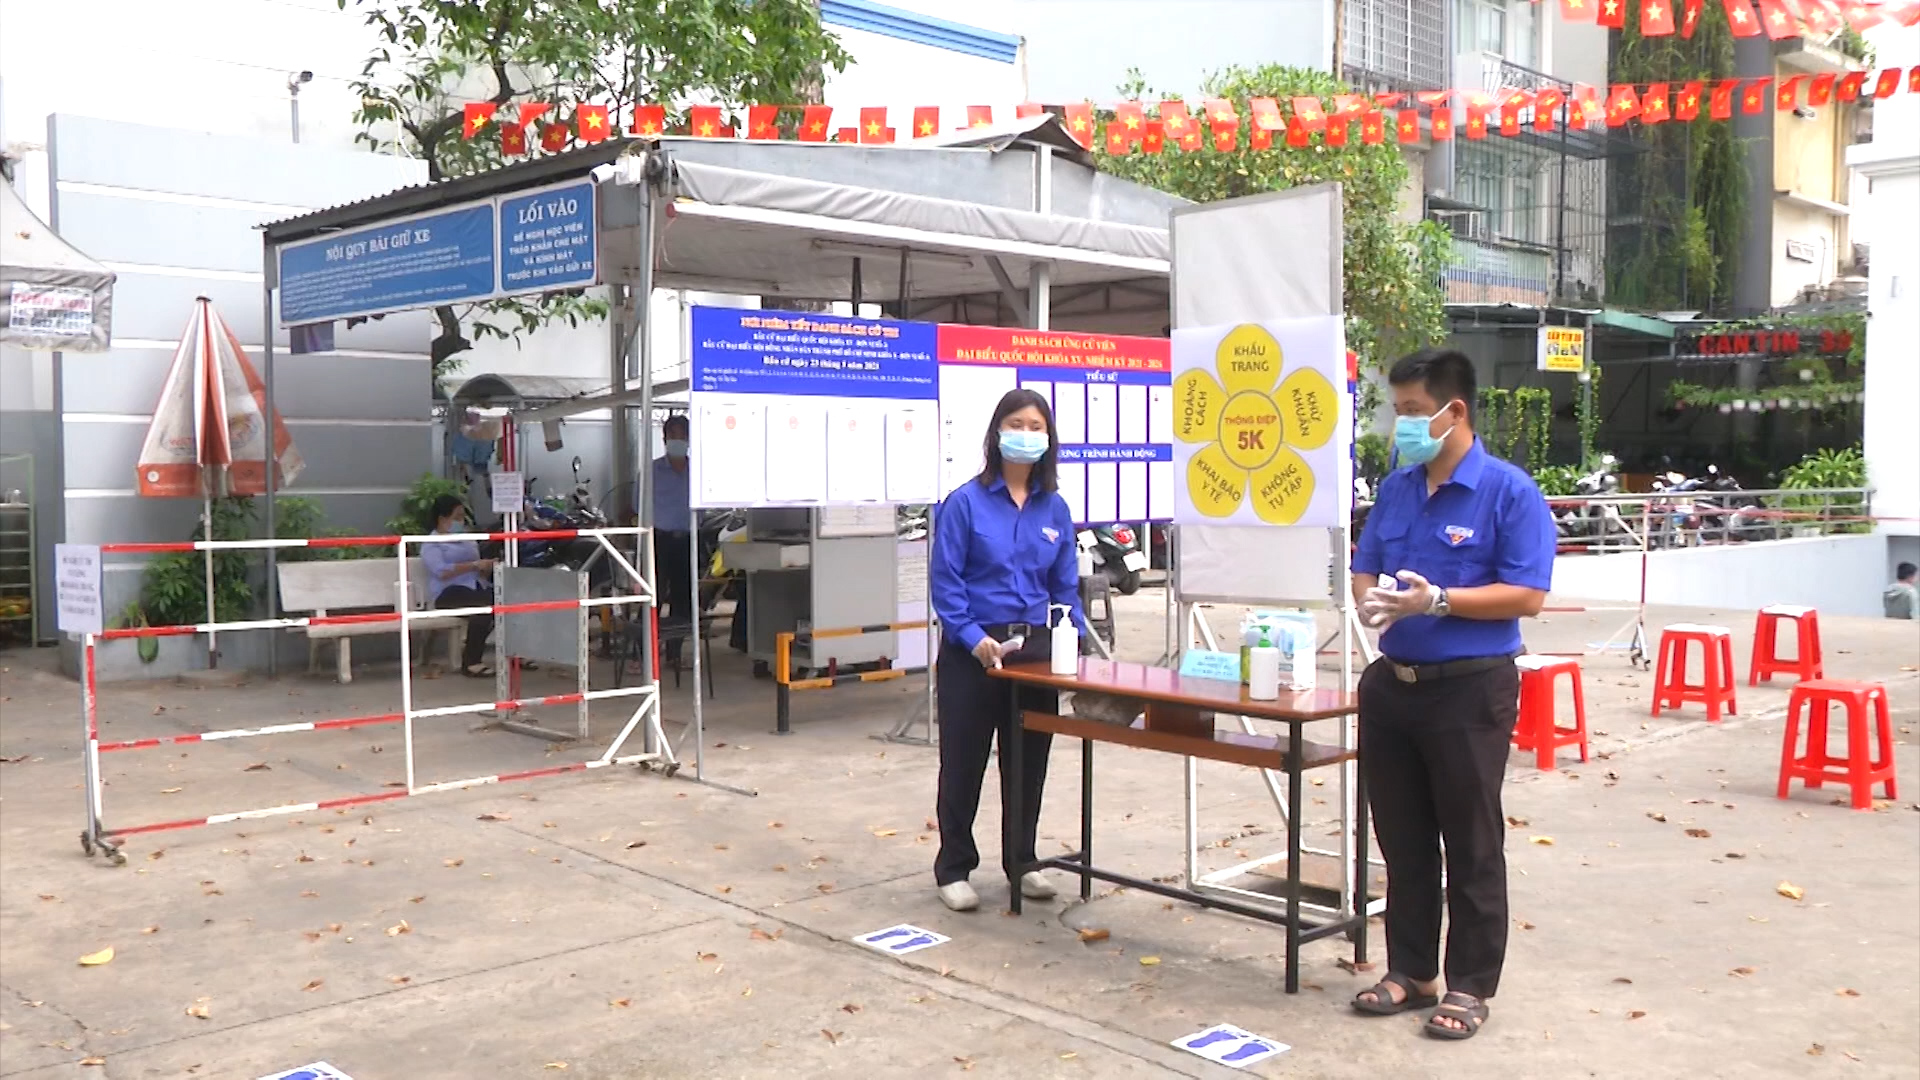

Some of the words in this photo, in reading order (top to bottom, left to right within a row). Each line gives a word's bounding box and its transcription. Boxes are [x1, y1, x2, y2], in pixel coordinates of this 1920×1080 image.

[518, 200, 543, 224] LỐI
[547, 198, 577, 217] VÀO
[325, 243, 344, 262] NỘI
[346, 241, 366, 260] QUY
[414, 228, 432, 244] XE
[1011, 335, 1037, 346] DANH
[1038, 335, 1062, 348] SÁCH
[1063, 335, 1081, 349] ỨNG
[1083, 337, 1095, 350] CỬ
[1096, 339, 1117, 351] VIÊN
[956, 349, 975, 361] ĐẠI
[976, 346, 998, 360] BIỂU
[1000, 348, 1025, 364] QUỐC
[1026, 350, 1043, 364] HỘI
[1085, 370, 1106, 382] TIỂU
[1231, 361, 1269, 372] TRANG
[1195, 391, 1207, 426] CÁCH
[1225, 416, 1254, 426] THÔNG
[1237, 430, 1265, 450] 5K
[1082, 448, 1108, 458] TRÌNH
[1109, 448, 1133, 458] HÀNH
[1134, 448, 1156, 459] ĐỘNG
[1196, 458, 1220, 483] KHAI
[1219, 479, 1241, 502] BÁO
[1201, 480, 1209, 490] Y
[1261, 463, 1298, 499] KHÔNG
[1269, 496, 1285, 510] TỤ
[1284, 477, 1303, 497] TẬP
